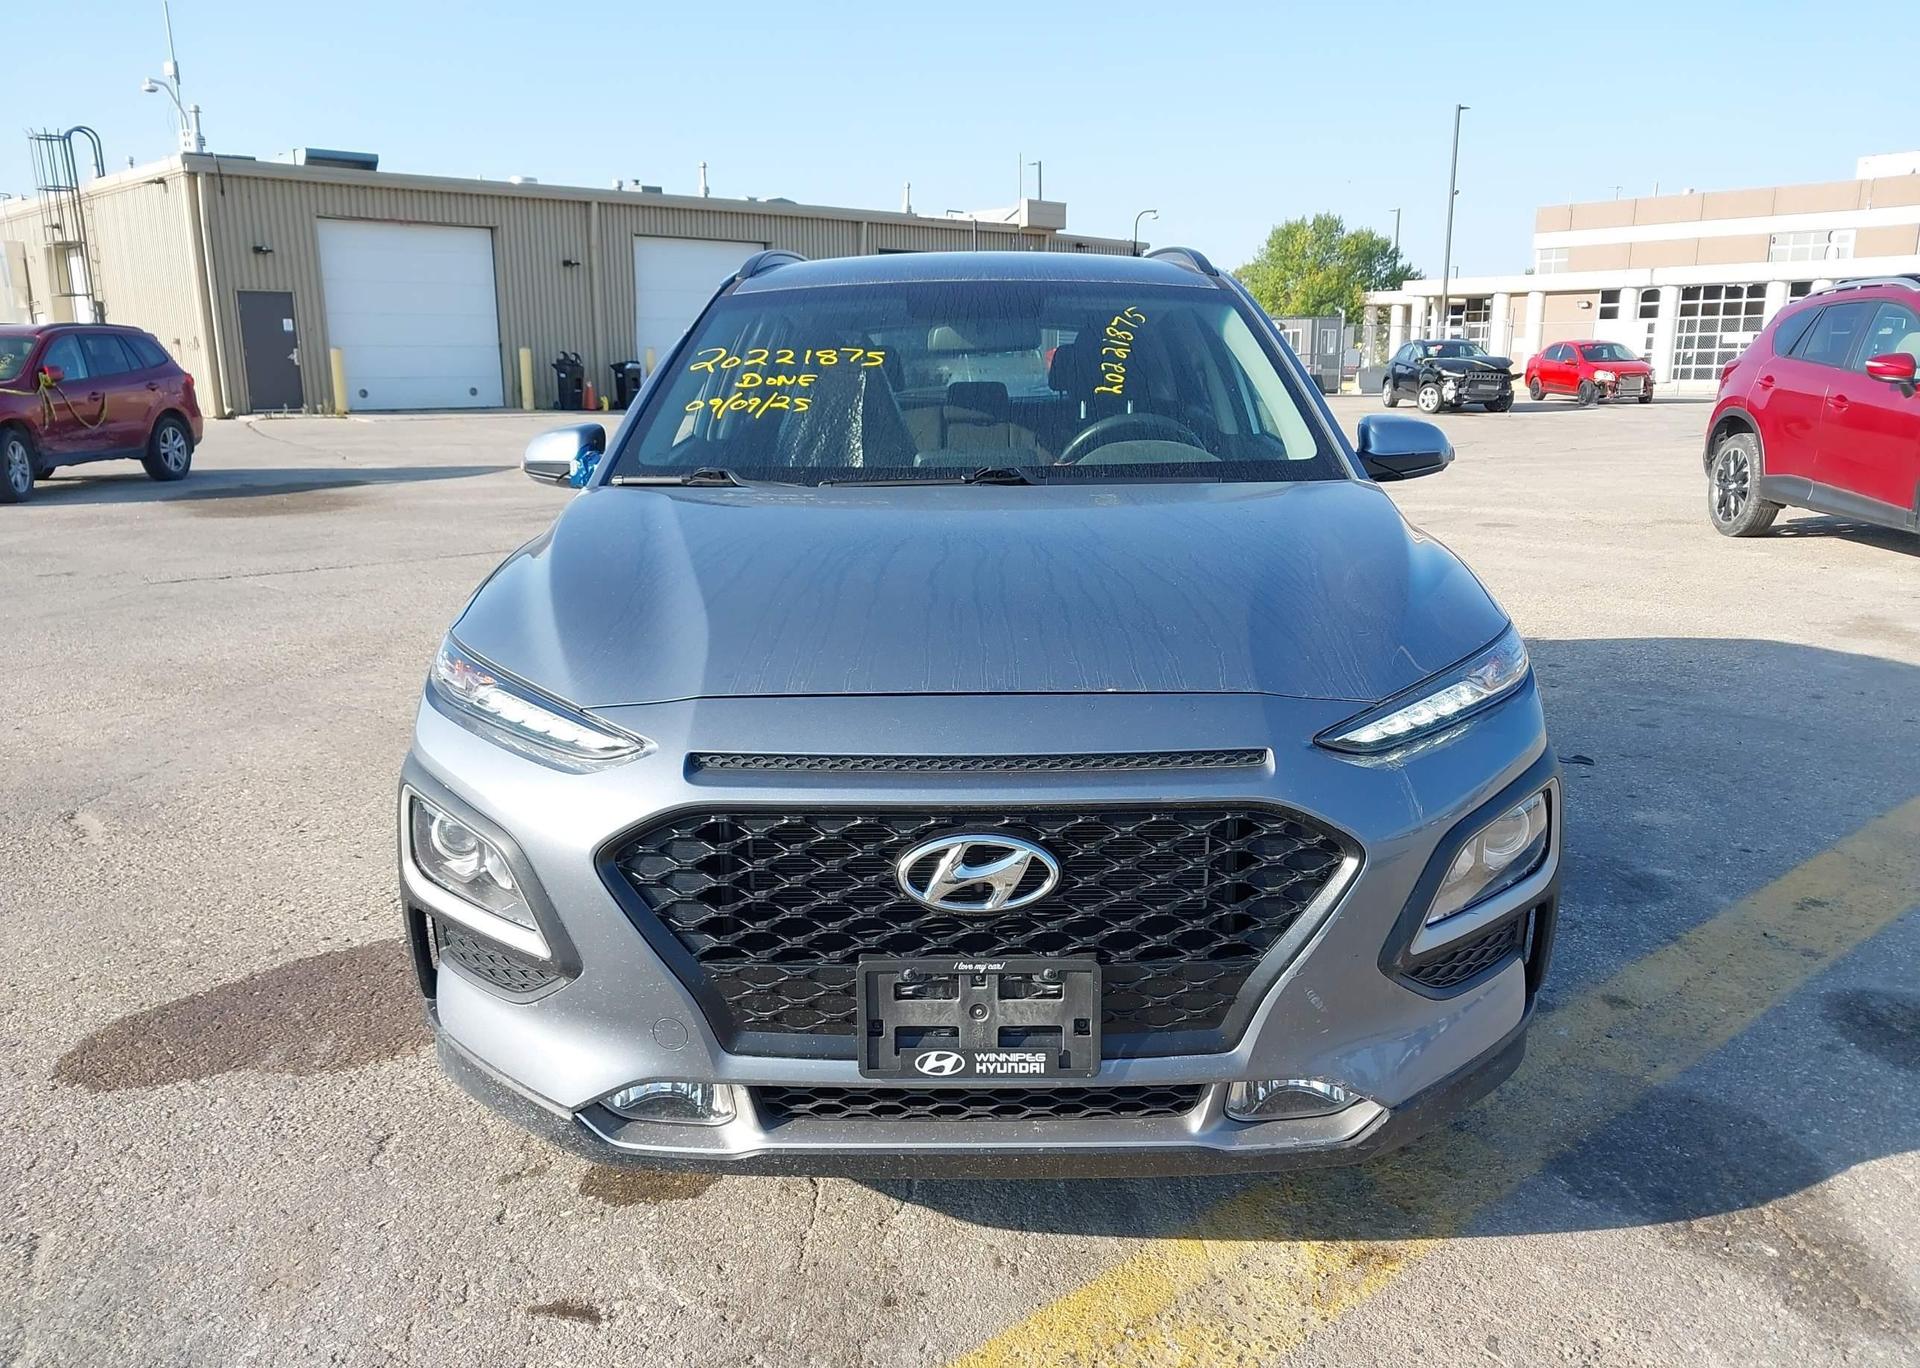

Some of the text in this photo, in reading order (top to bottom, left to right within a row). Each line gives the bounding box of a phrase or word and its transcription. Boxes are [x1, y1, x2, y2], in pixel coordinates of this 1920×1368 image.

[1094, 306, 1146, 394] 20221875
[689, 347, 886, 373] 20221875
[734, 372, 818, 388] DONE
[684, 391, 812, 420] 09/09/25
[958, 961, 973, 970] love
[974, 963, 987, 974] my
[974, 1052, 1046, 1062] WINNIPEG
[975, 1062, 1045, 1074] HYUNDAI
